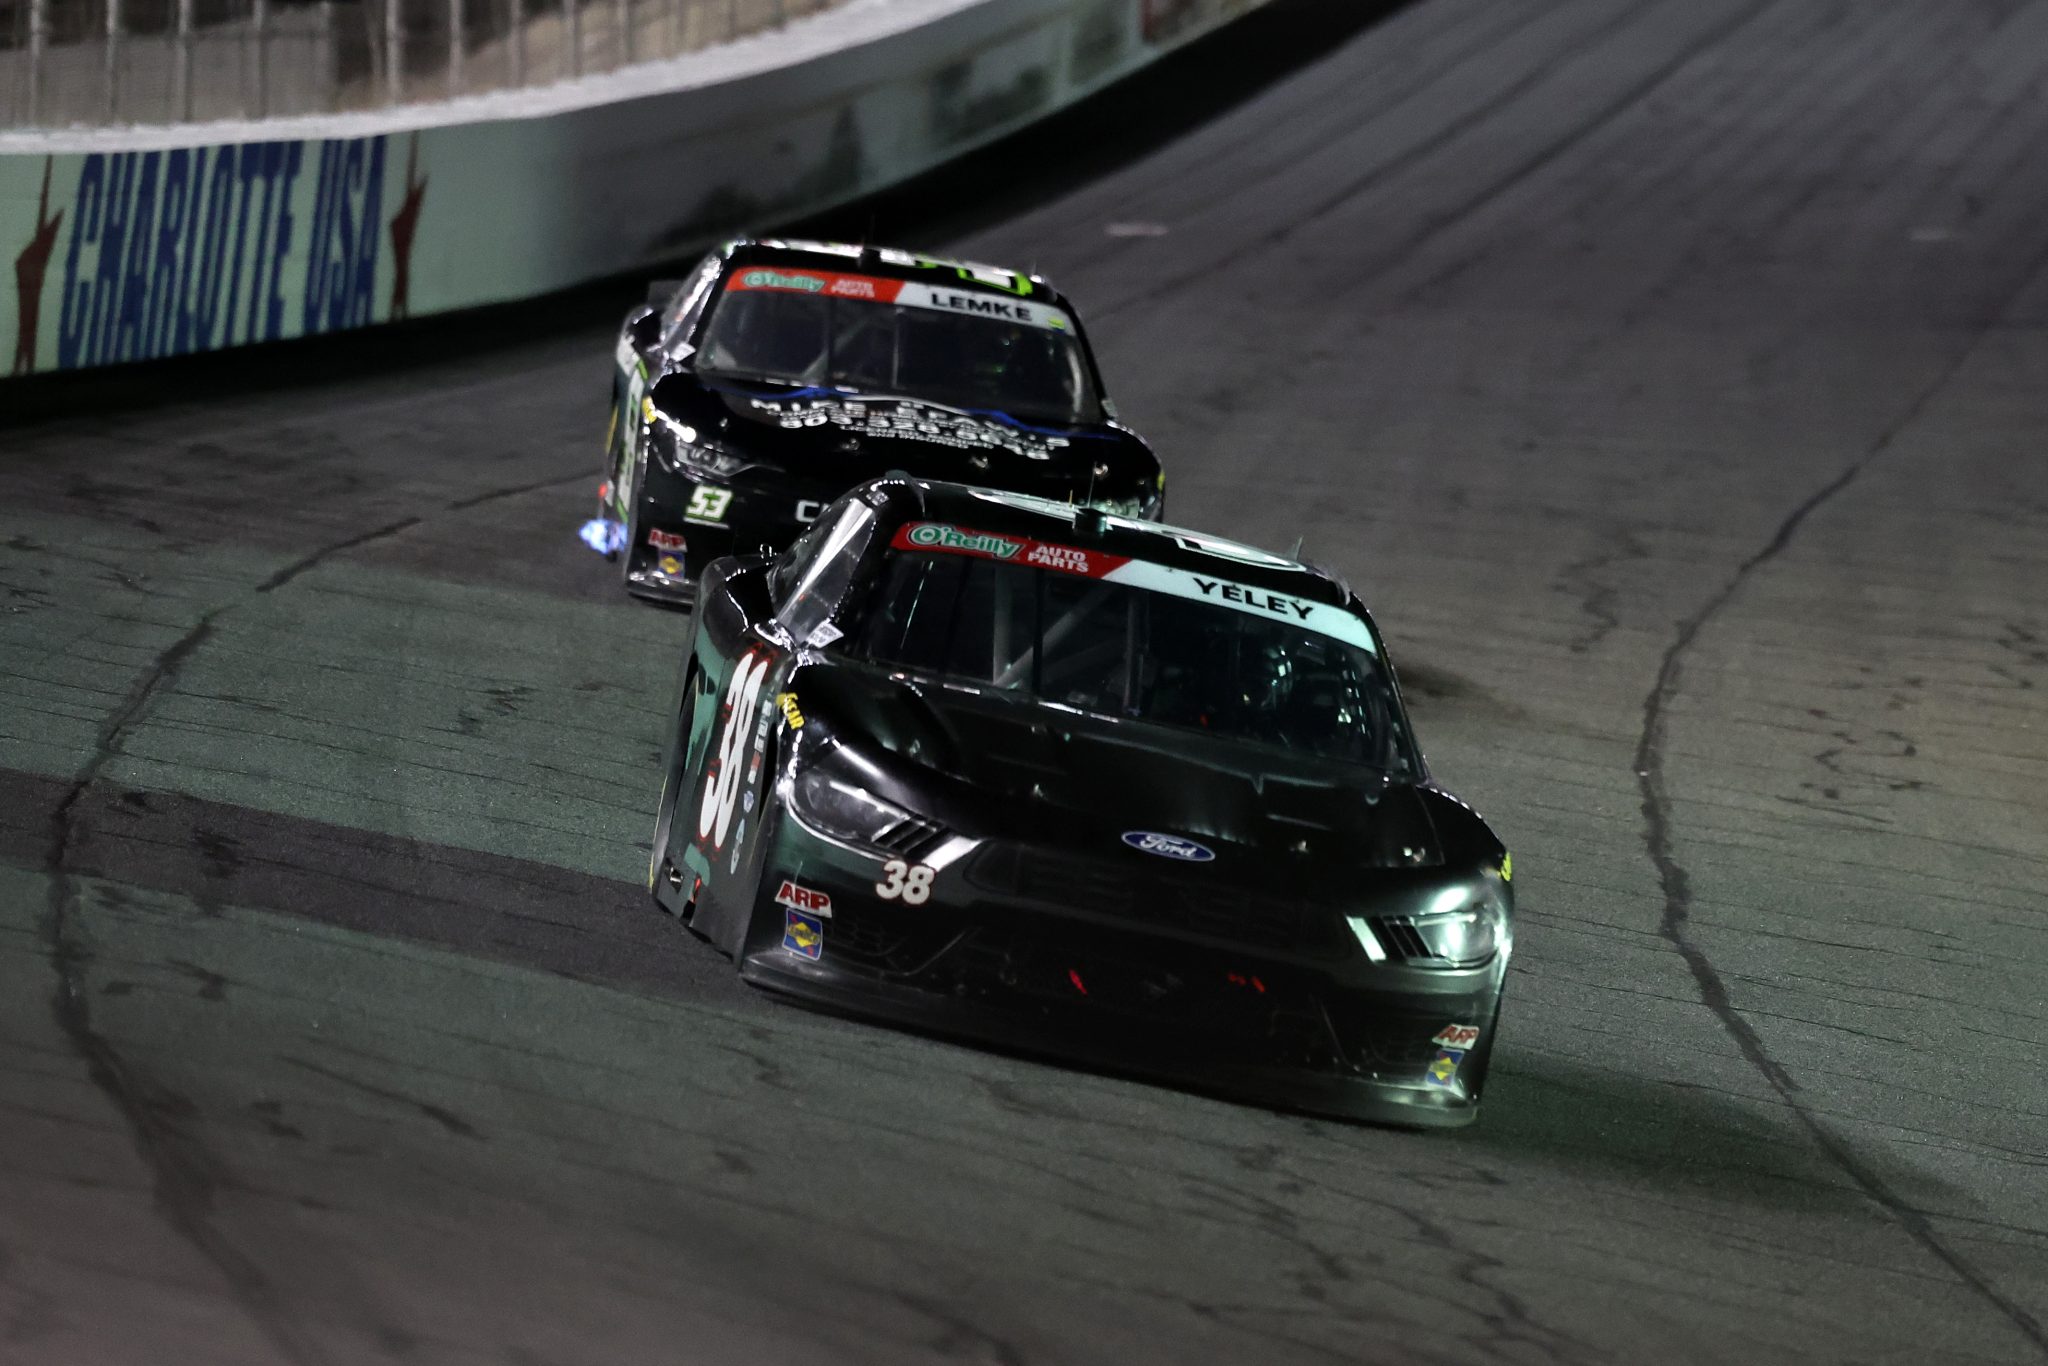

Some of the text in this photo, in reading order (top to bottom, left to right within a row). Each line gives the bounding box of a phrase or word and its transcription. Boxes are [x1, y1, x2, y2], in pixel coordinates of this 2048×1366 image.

[931, 292, 1033, 321] LEMKE
[687, 486, 732, 520] 53
[907, 524, 1024, 559] O'Reilly
[1035, 543, 1087, 562] AUTO
[1027, 552, 1090, 573] PARTS
[1193, 577, 1315, 620] YELEY
[1140, 835, 1197, 857] Ford
[779, 881, 831, 911] ARP
[876, 859, 935, 905] 38
